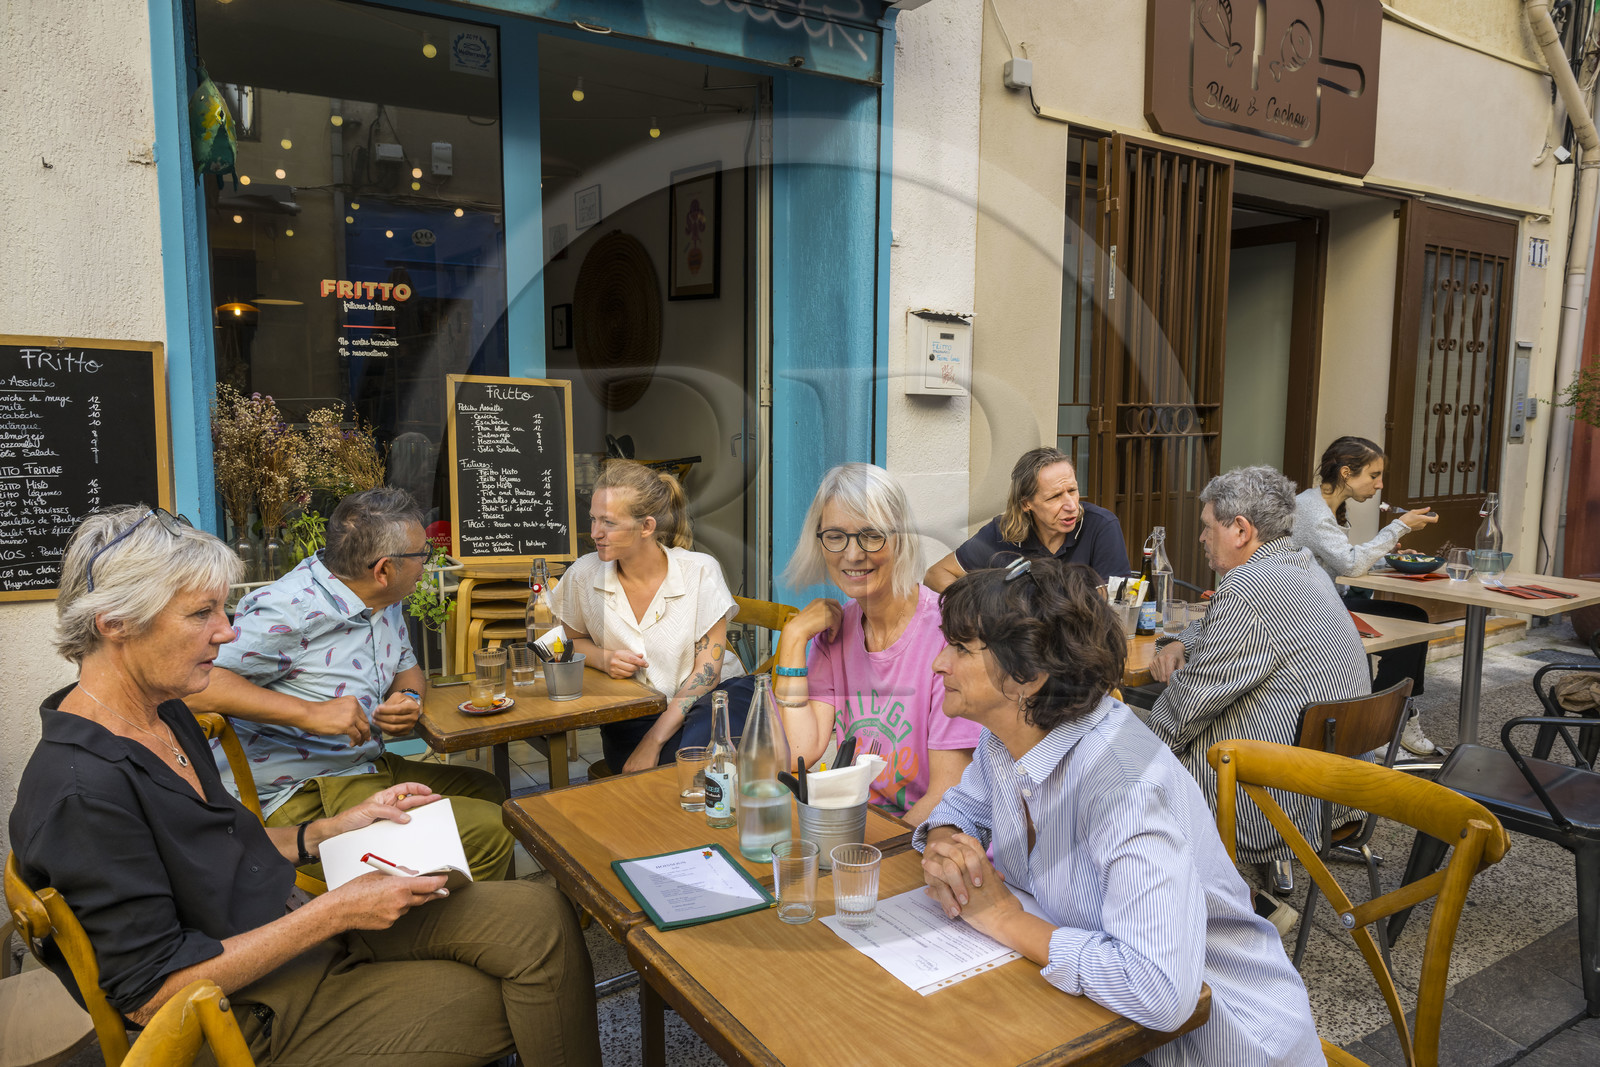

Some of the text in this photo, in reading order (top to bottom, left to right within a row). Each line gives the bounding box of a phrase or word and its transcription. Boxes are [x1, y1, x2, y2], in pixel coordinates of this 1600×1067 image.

[1204, 81, 1310, 130] Bleu & Cochon
[1532, 243, 1544, 262] 11
[320, 279, 412, 302] FRITTO
[338, 337, 350, 346] No
[370, 338, 399, 346] bancaires
[338, 348, 350, 356] No
[8, 375, 56, 388] Assiettes
[0, 402, 26, 411] onite
[0, 421, 41, 435] outargue
[0, 439, 97, 448] ozzarella 9
[0, 449, 16, 458] olie
[22, 448, 60, 458] Salade
[88, 478, 99, 488] 16
[88, 496, 100, 504] 18
